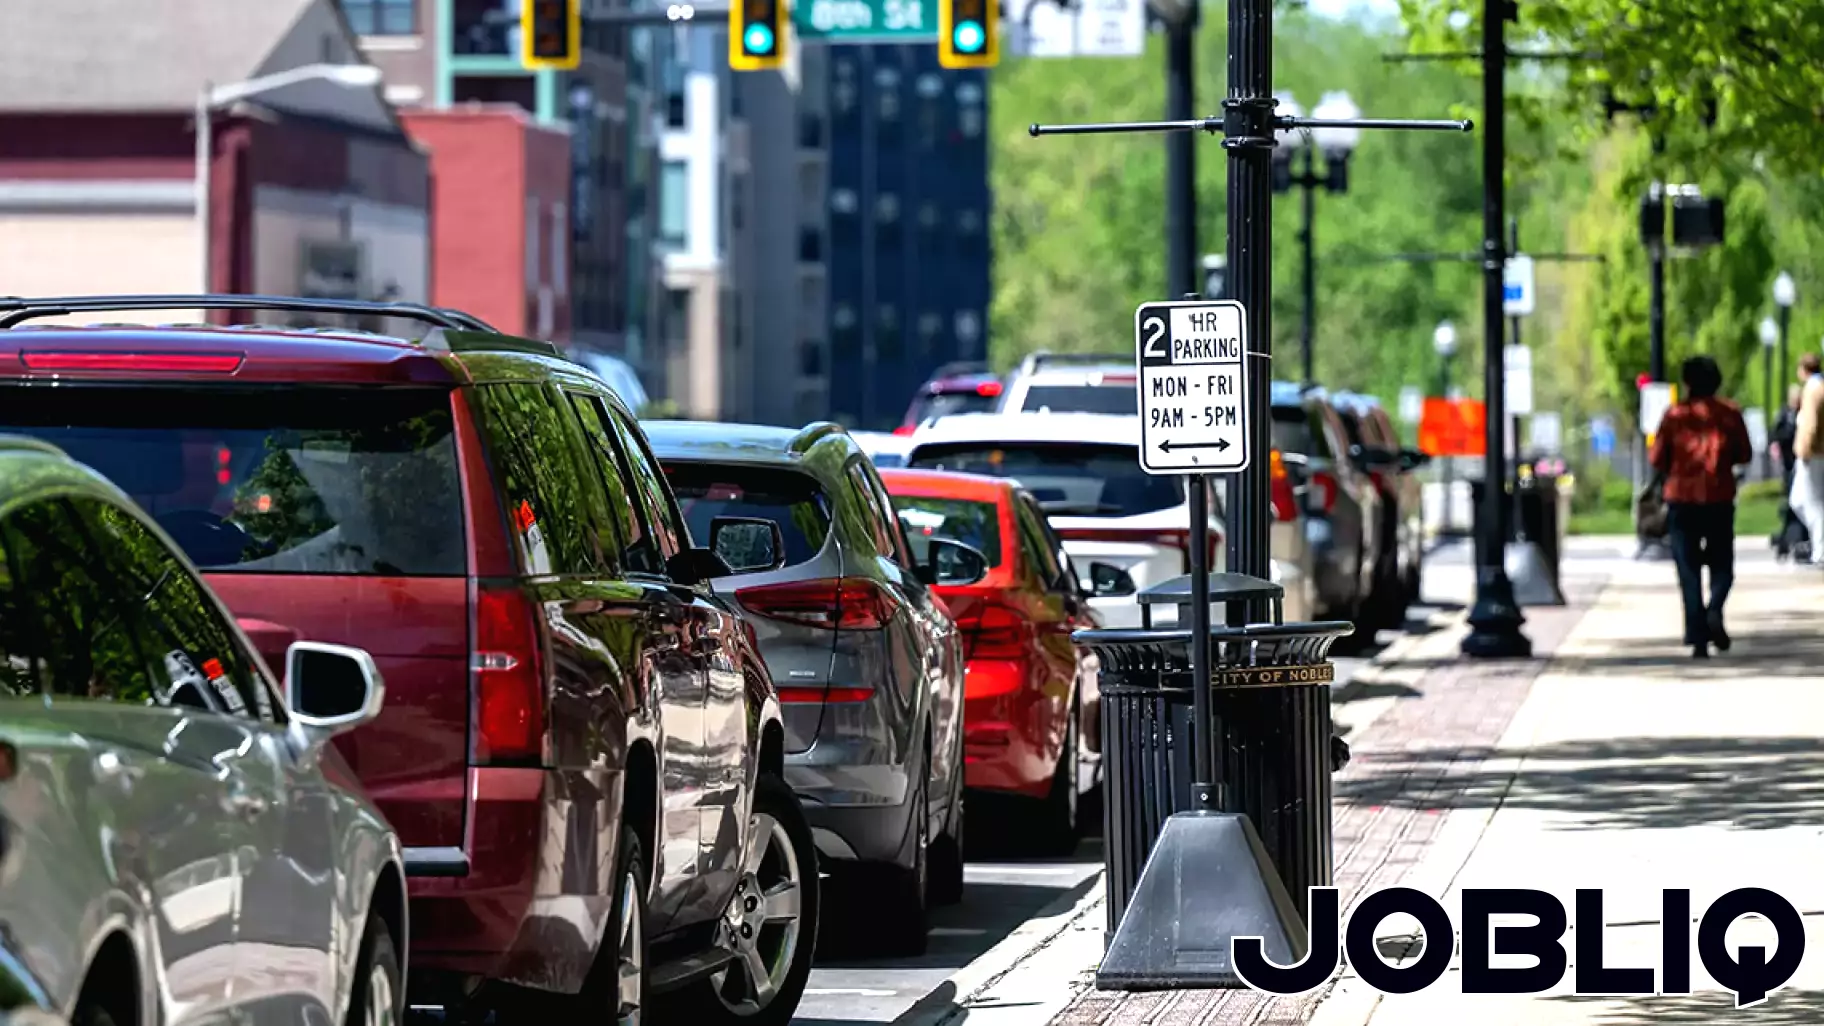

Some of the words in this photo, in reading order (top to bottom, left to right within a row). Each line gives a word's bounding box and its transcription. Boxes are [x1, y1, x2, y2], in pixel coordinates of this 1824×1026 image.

[882, 0, 923, 30] St
[1143, 316, 1167, 358] 2
[1191, 312, 1218, 332] HR
[1173, 338, 1239, 359] PARKING
[1152, 376, 1188, 398] MON
[1207, 375, 1233, 396] FRI
[1151, 407, 1185, 429] 9AM
[1204, 405, 1237, 427] 5PM
[1211, 672, 1252, 685] CITY
[1259, 671, 1282, 683] OF
